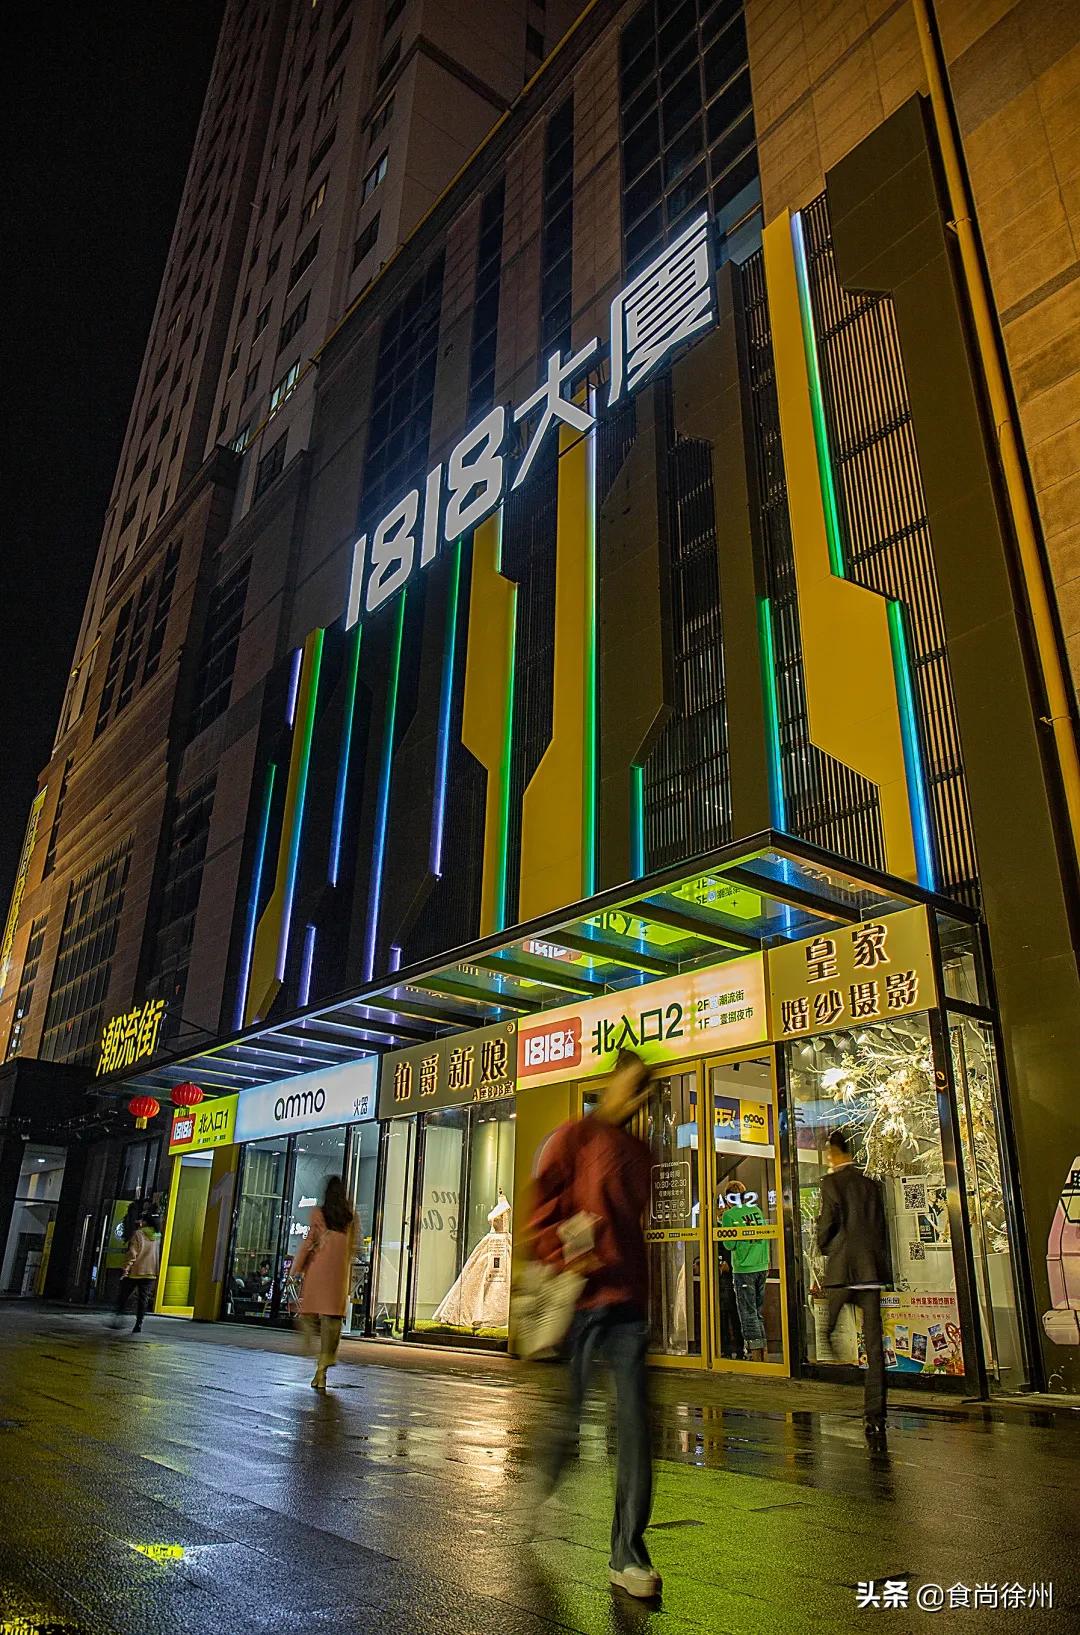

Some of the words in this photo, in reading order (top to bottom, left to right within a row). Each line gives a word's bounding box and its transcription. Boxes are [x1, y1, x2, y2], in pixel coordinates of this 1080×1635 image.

[805, 923, 890, 984] 皇家
[697, 998, 709, 1012] 2F
[719, 990, 745, 1006] 潮流街
[781, 970, 919, 1035] 婚纱摄影
[96, 1000, 165, 1077] 潮流街
[591, 1003, 684, 1055] 北入口2
[698, 1017, 710, 1030] 1F
[199, 1109, 229, 1135] 北入口1
[274, 1088, 326, 1121] ammo
